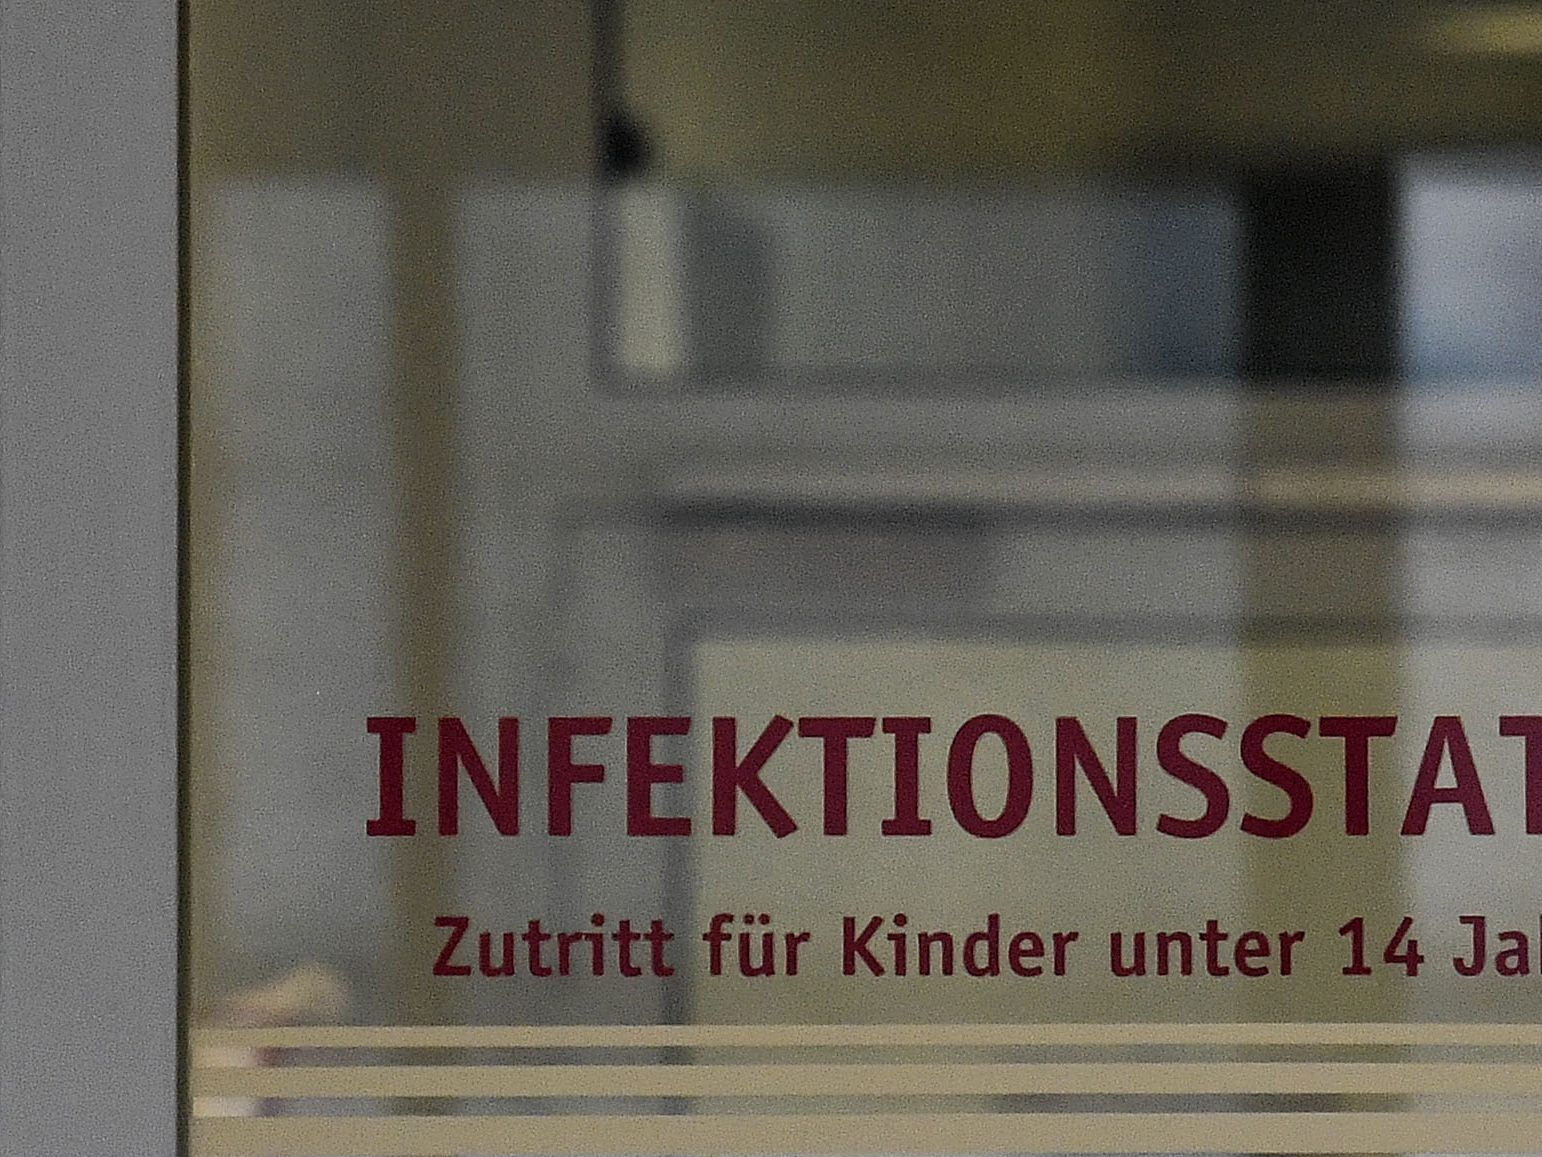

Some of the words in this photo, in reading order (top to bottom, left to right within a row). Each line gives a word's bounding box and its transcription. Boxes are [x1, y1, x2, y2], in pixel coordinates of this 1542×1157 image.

[433, 914, 674, 978] Zutritt
[703, 913, 811, 977] für
[843, 913, 1079, 977] Kinder
[1110, 919, 1305, 977] unter
[1340, 917, 1424, 976] 14
